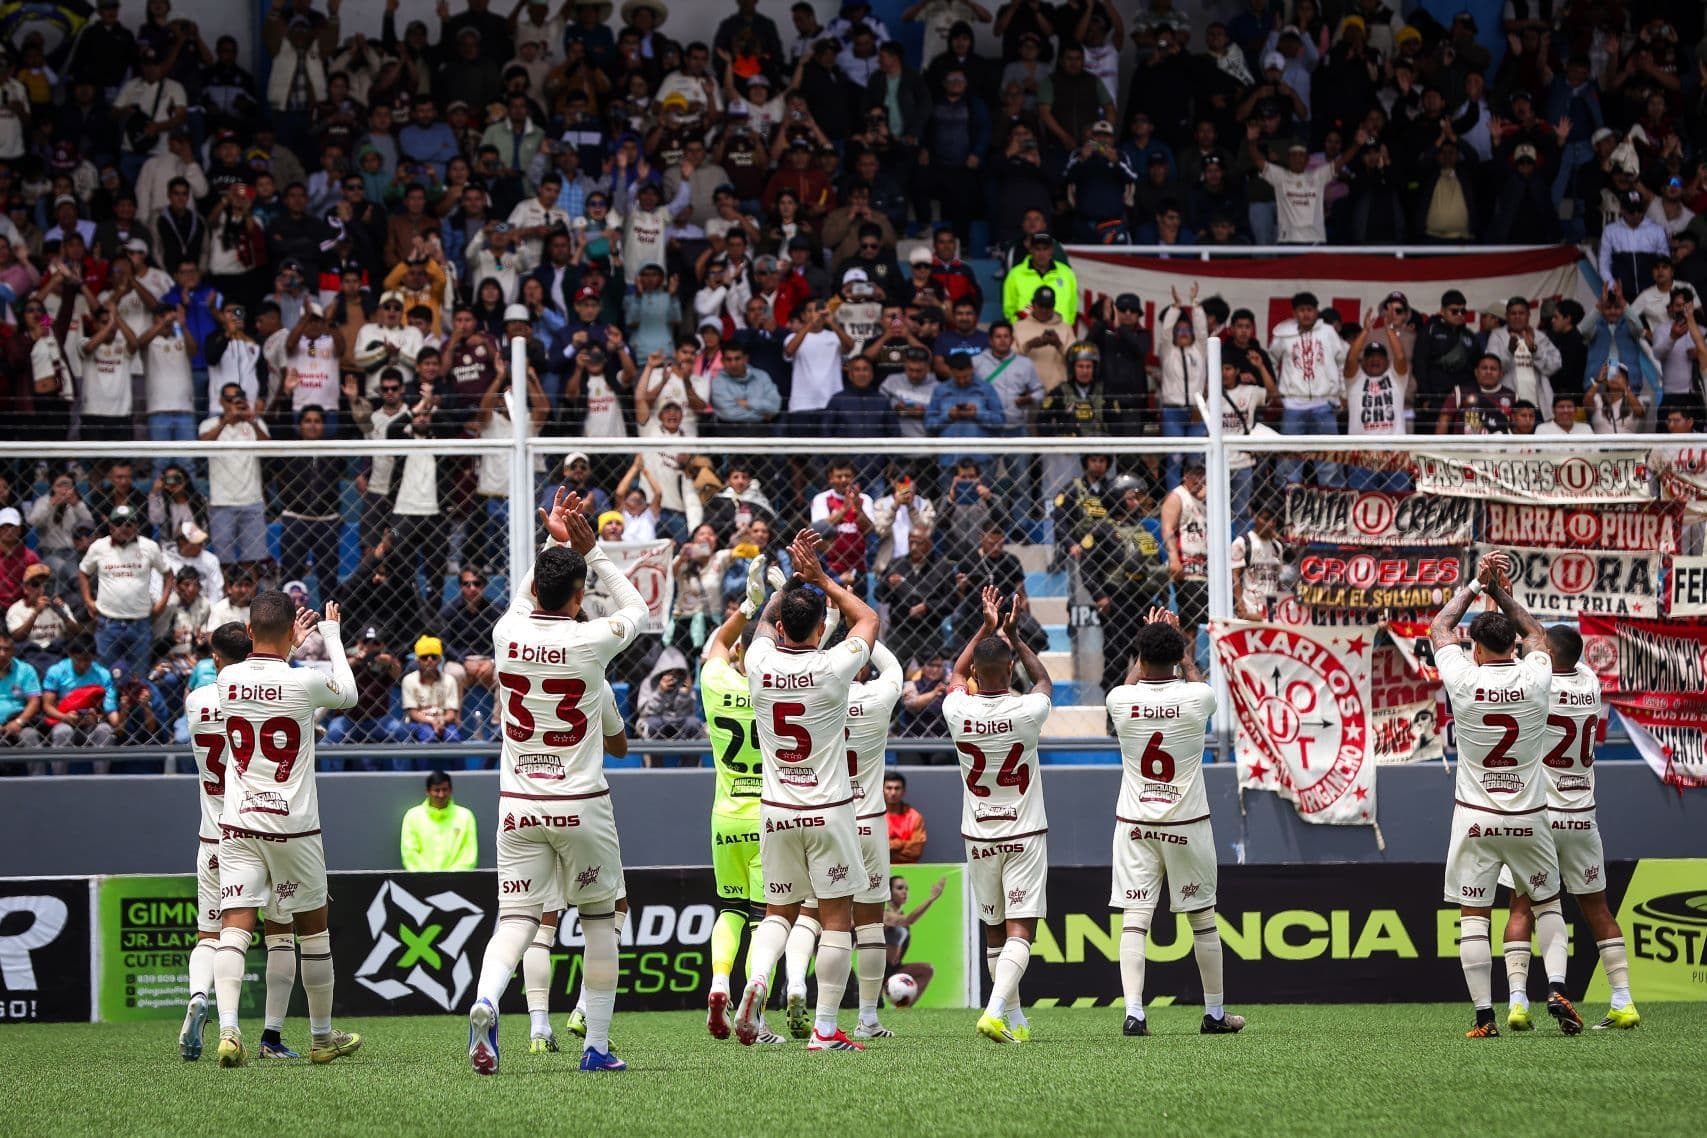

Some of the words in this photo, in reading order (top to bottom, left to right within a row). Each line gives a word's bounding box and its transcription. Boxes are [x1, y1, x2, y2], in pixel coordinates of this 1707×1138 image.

[1416, 456, 1464, 487] LAS
[1490, 504, 1566, 542] BARRA
[1602, 512, 1676, 552] PIURA
[1300, 555, 1460, 588] CRUELES
[1351, 588, 1368, 606] EL
[522, 644, 566, 665] bitel
[776, 672, 814, 689] bitel
[1245, 630, 1361, 718] KARLOS
[241, 684, 282, 700] bitel
[1488, 688, 1524, 702] bitel
[1570, 692, 1595, 706] bitel
[499, 672, 588, 747] 33
[1143, 706, 1180, 719] bitel
[772, 702, 812, 762] 5
[975, 719, 1013, 735] bitel
[1483, 714, 1519, 768] 2
[1542, 714, 1598, 768] 20
[227, 716, 300, 783] 99
[1140, 731, 1176, 783] 6
[519, 754, 561, 766] HINCHADA
[956, 742, 1029, 797] 24
[519, 814, 581, 828] ALTOS
[777, 816, 825, 831] ALTOS
[1551, 821, 1591, 830] ALTOS
[725, 832, 760, 845] ALTO
[1144, 830, 1188, 845] ALTOS
[1484, 827, 1533, 837] ALTOS
[981, 843, 1024, 858] ALTOS
[503, 879, 532, 894] SKY
[724, 884, 743, 895] SKY
[770, 882, 792, 894] SKY
[1461, 886, 1486, 898] SKY
[1125, 889, 1148, 900] SKY
[124, 933, 153, 947] JR.
[158, 933, 181, 946] LA
[1034, 908, 1419, 963] ANUNCIA
[1633, 922, 1707, 965] EST
[1692, 970, 1707, 984] PU
